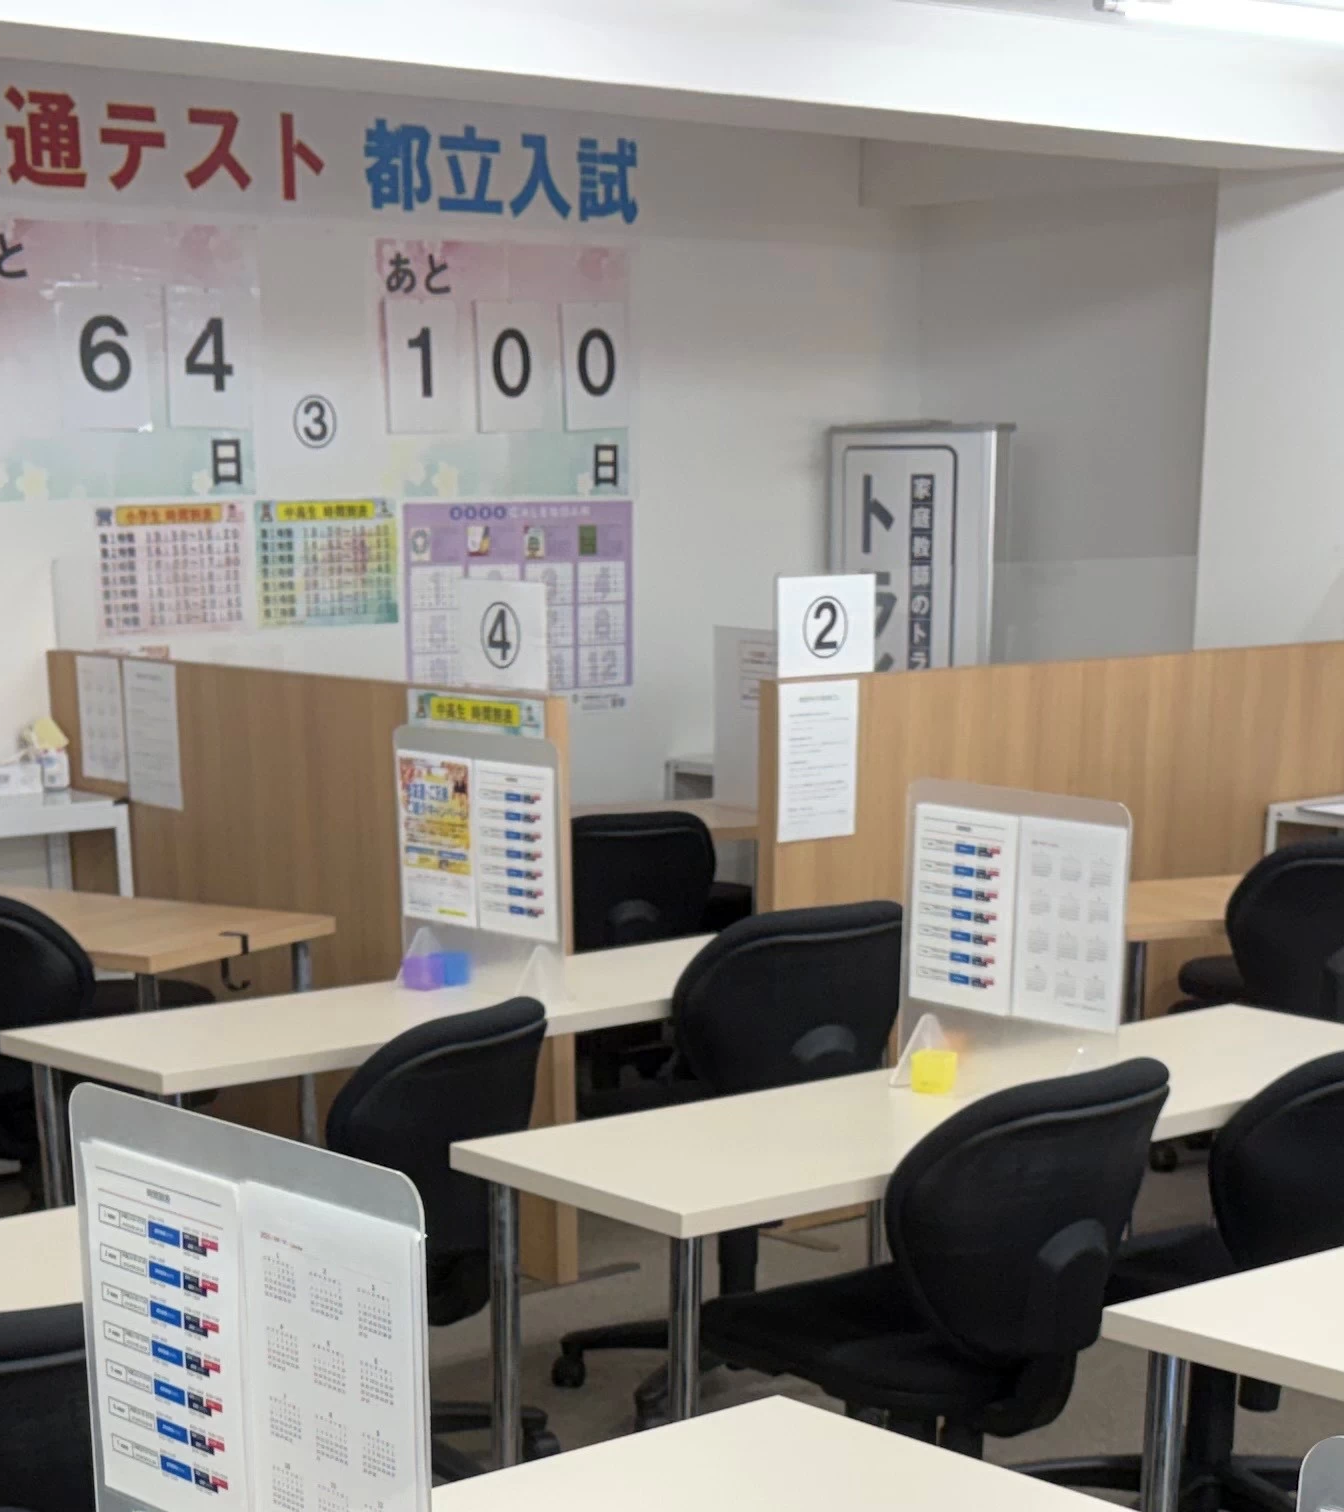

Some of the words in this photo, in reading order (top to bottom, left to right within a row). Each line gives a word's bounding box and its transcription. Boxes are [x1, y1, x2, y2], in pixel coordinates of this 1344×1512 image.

[363, 118, 640, 225] 都立入試
[385, 252, 452, 296] あと
[211, 438, 243, 488] 日
[592, 442, 621, 488] 日
